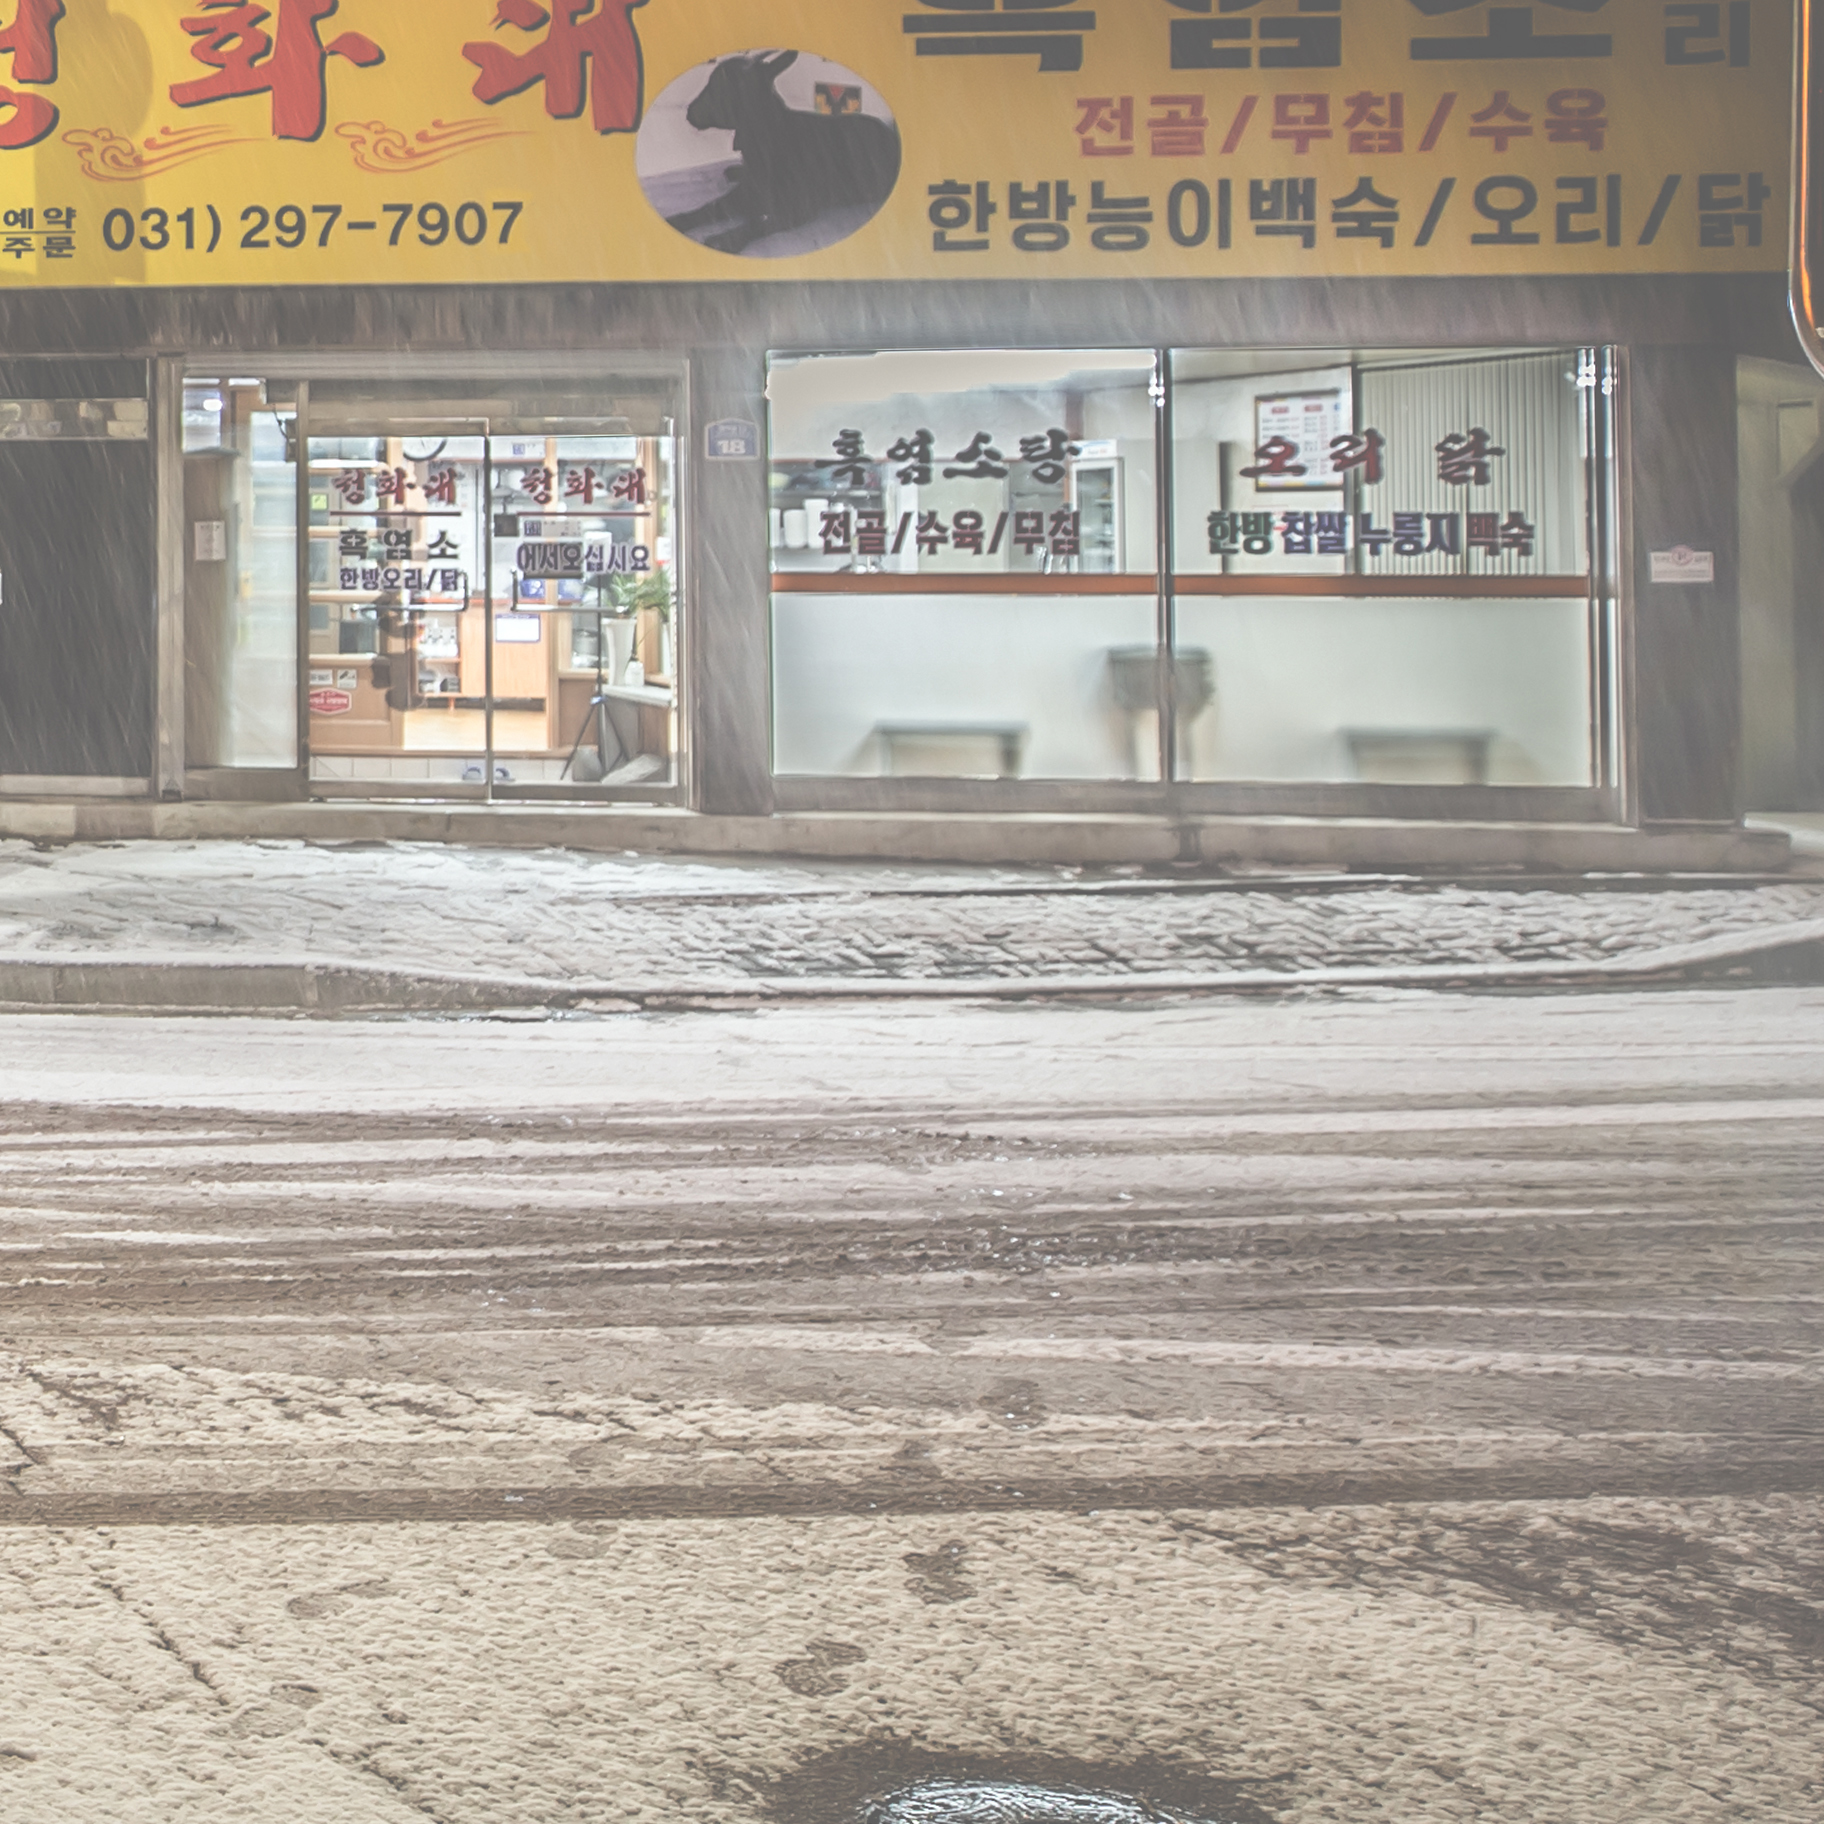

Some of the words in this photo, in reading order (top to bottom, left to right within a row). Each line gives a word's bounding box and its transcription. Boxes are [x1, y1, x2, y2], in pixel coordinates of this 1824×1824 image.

[1073, 87, 1610, 159] 전골/무침/수육
[1, 206, 77, 230] 예약
[102, 206, 223, 253] 031)
[239, 200, 525, 249] 297-7907
[924, 172, 1772, 254] 한방능이백숙/오리/닭
[1, 235, 77, 259] 주문
[716, 439, 746, 455] 18
[813, 427, 1083, 487] 흑염소탕
[1239, 426, 1387, 486] 오리
[1434, 426, 1508, 487] 닭
[332, 466, 458, 505] 청화대
[520, 466, 647, 506] 청화대
[338, 527, 460, 561] 흑염소
[818, 509, 1081, 556] 전골/수육/무침
[516, 543, 651, 573] 어서오십시요
[339, 567, 459, 592] 한방오리/닭
